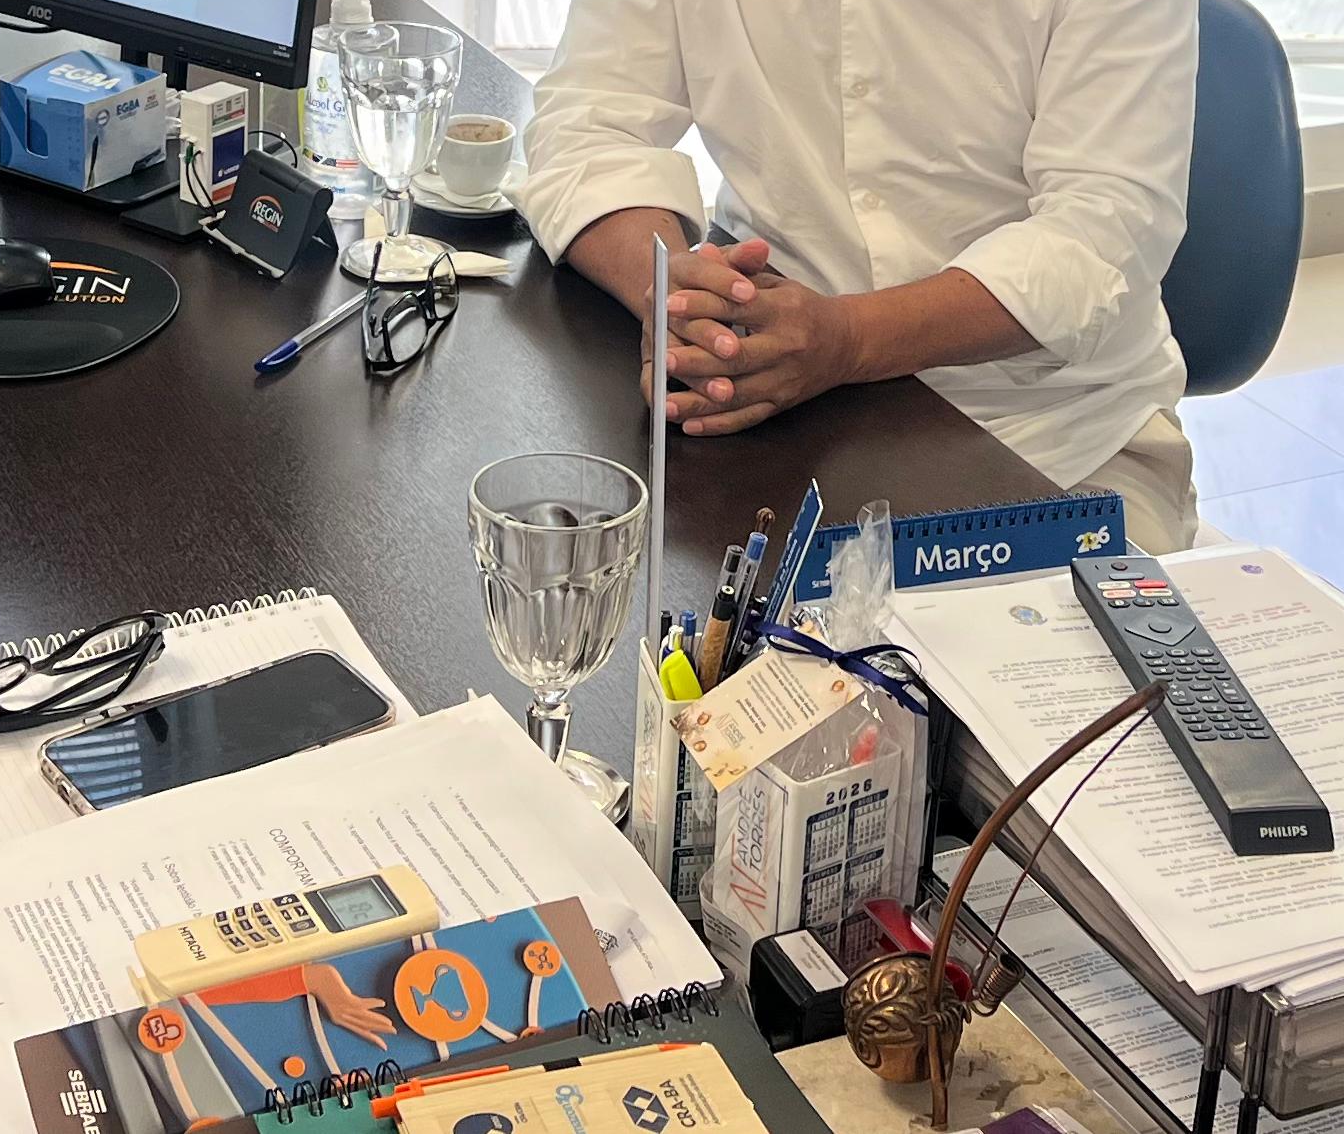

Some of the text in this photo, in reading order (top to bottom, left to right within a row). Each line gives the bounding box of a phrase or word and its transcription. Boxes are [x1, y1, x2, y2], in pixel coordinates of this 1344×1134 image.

[27, 5, 52, 21] AOC
[116, 98, 140, 116] EGBA
[253, 200, 284, 227] REGIN
[914, 542, 1012, 576] Março
[826, 778, 873, 805] 2026
[1259, 825, 1308, 838] PHILIPS
[178, 926, 206, 961] HITACHI
[659, 1079, 697, 1128] CRA-BA
